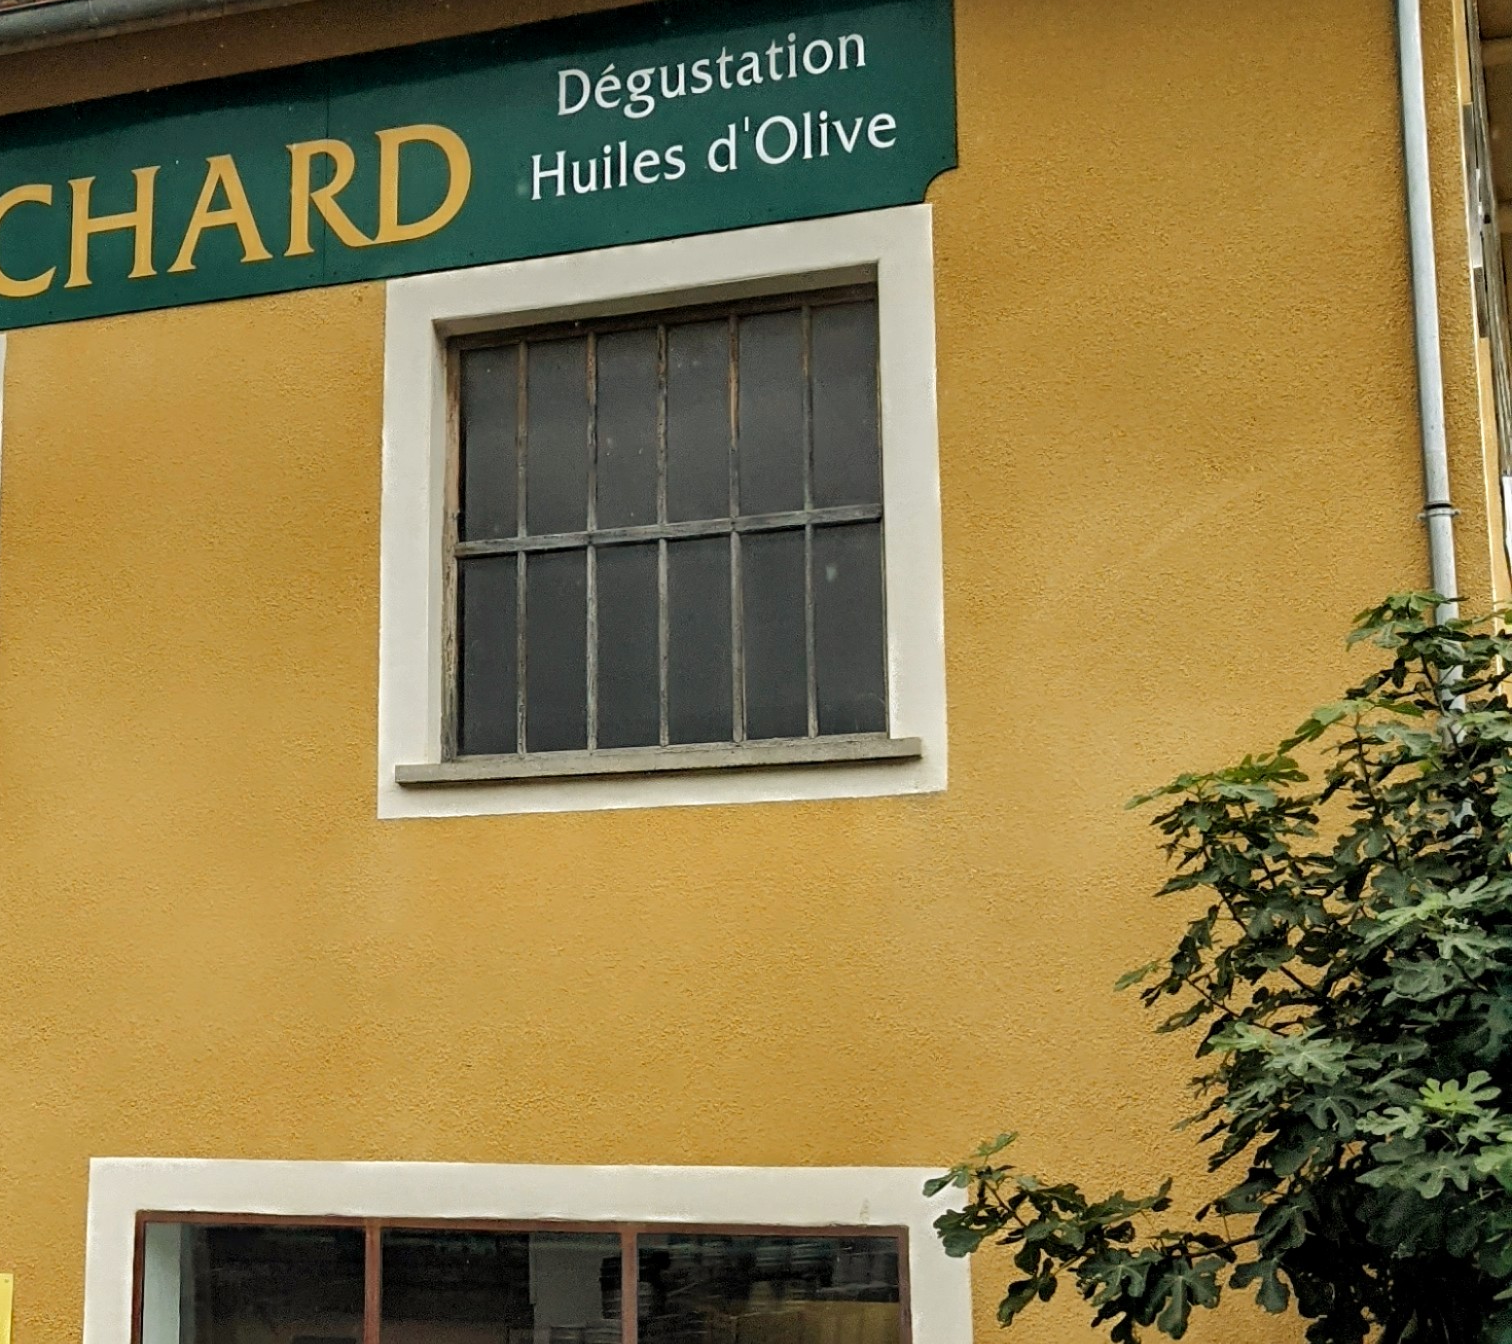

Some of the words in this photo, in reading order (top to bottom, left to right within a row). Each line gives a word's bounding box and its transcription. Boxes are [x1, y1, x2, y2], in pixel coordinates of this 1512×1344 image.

[556, 32, 867, 120] Dégustation
[530, 140, 687, 201] Huiles
[707, 110, 898, 173] d'Olive
